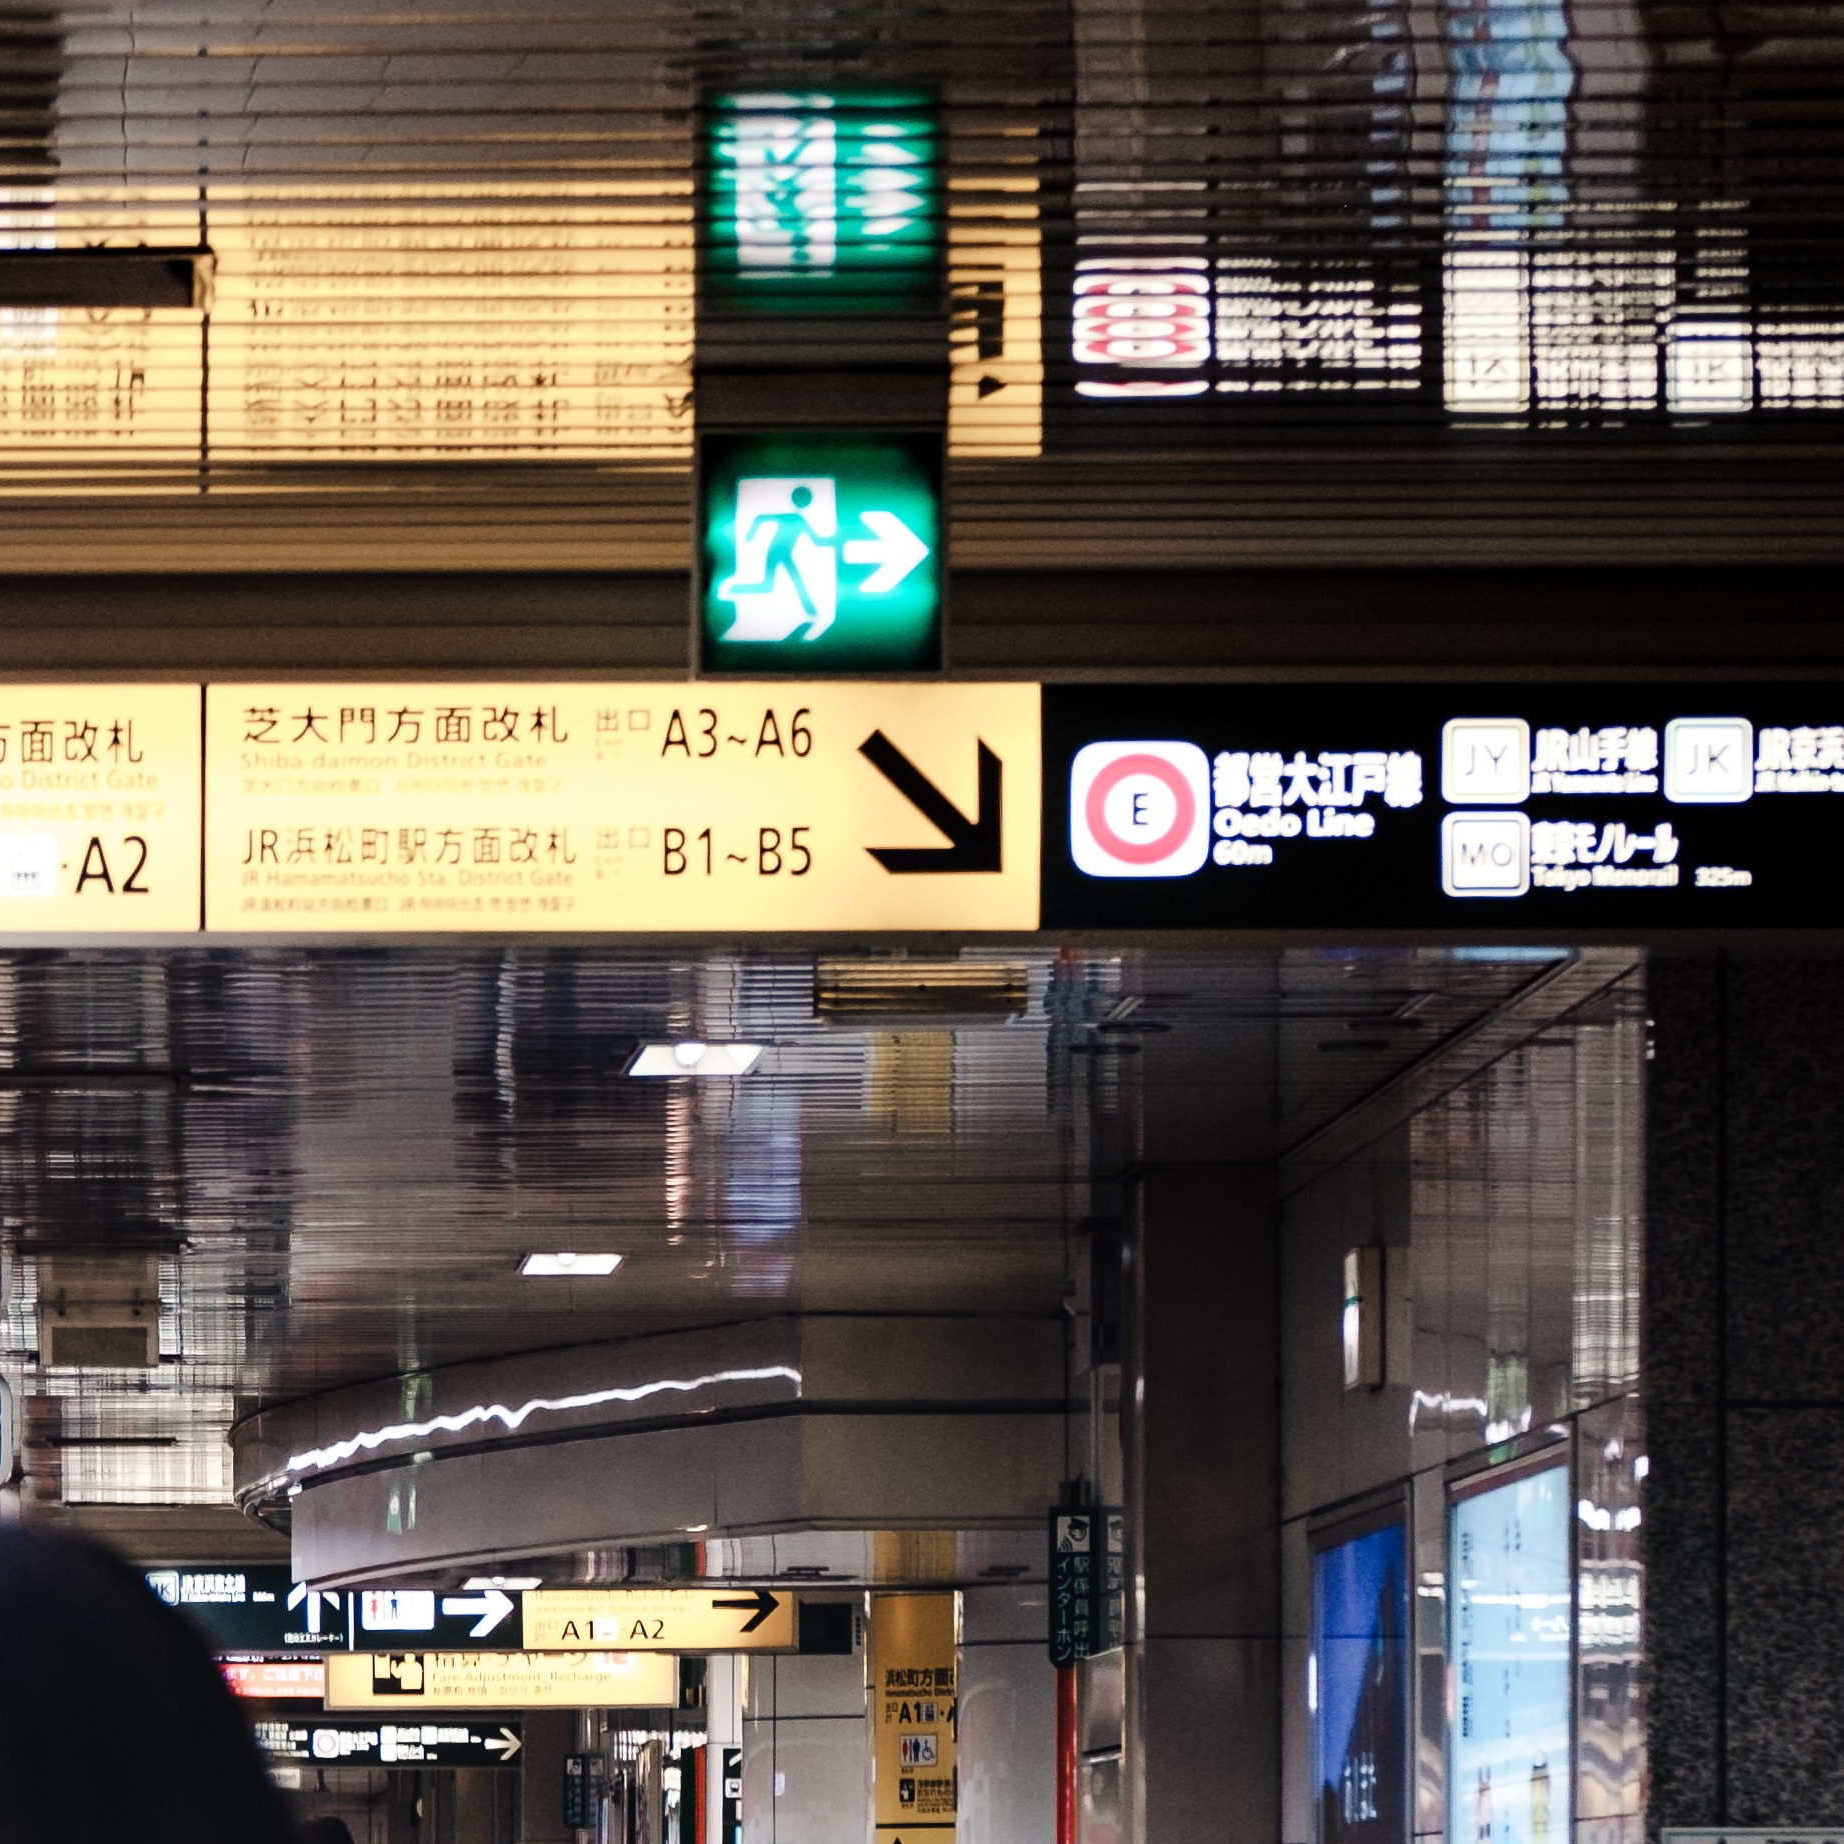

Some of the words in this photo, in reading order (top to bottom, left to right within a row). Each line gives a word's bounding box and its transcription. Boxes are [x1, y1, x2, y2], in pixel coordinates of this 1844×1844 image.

[243, 706, 568, 744] 芝大門方面改札
[596, 708, 650, 732] 出口
[242, 752, 398, 770] Shiba-daimon
[407, 752, 486, 770] District
[495, 752, 548, 770] Gate
[1464, 744, 1508, 777] JY
[1687, 743, 1730, 777] JK
[21, 770, 100, 791] District
[107, 770, 159, 791] Gate
[1214, 808, 1302, 836] Oedo
[1308, 808, 1375, 836] Line
[242, 828, 576, 865] JR浜松町駅方面改札
[1214, 841, 1272, 864] 60m
[1460, 842, 1513, 867] MO
[75, 836, 150, 895] A2
[241, 870, 260, 887] JR
[267, 870, 411, 887] Hamamatsucho
[417, 870, 450, 887] Sta.
[458, 870, 526, 887] District
[531, 870, 575, 887] Gate
[1056, 1557, 1073, 1661] インターホン
[1073, 1556, 1090, 1660] 駅係員呼出
[561, 1620, 594, 1641] A1
[630, 1620, 665, 1640] A2
[433, 1672, 462, 1683] Fare
[550, 1672, 612, 1685] Recharge
[886, 1668, 954, 1687] 浜松町方面
[899, 1702, 921, 1724] A1
